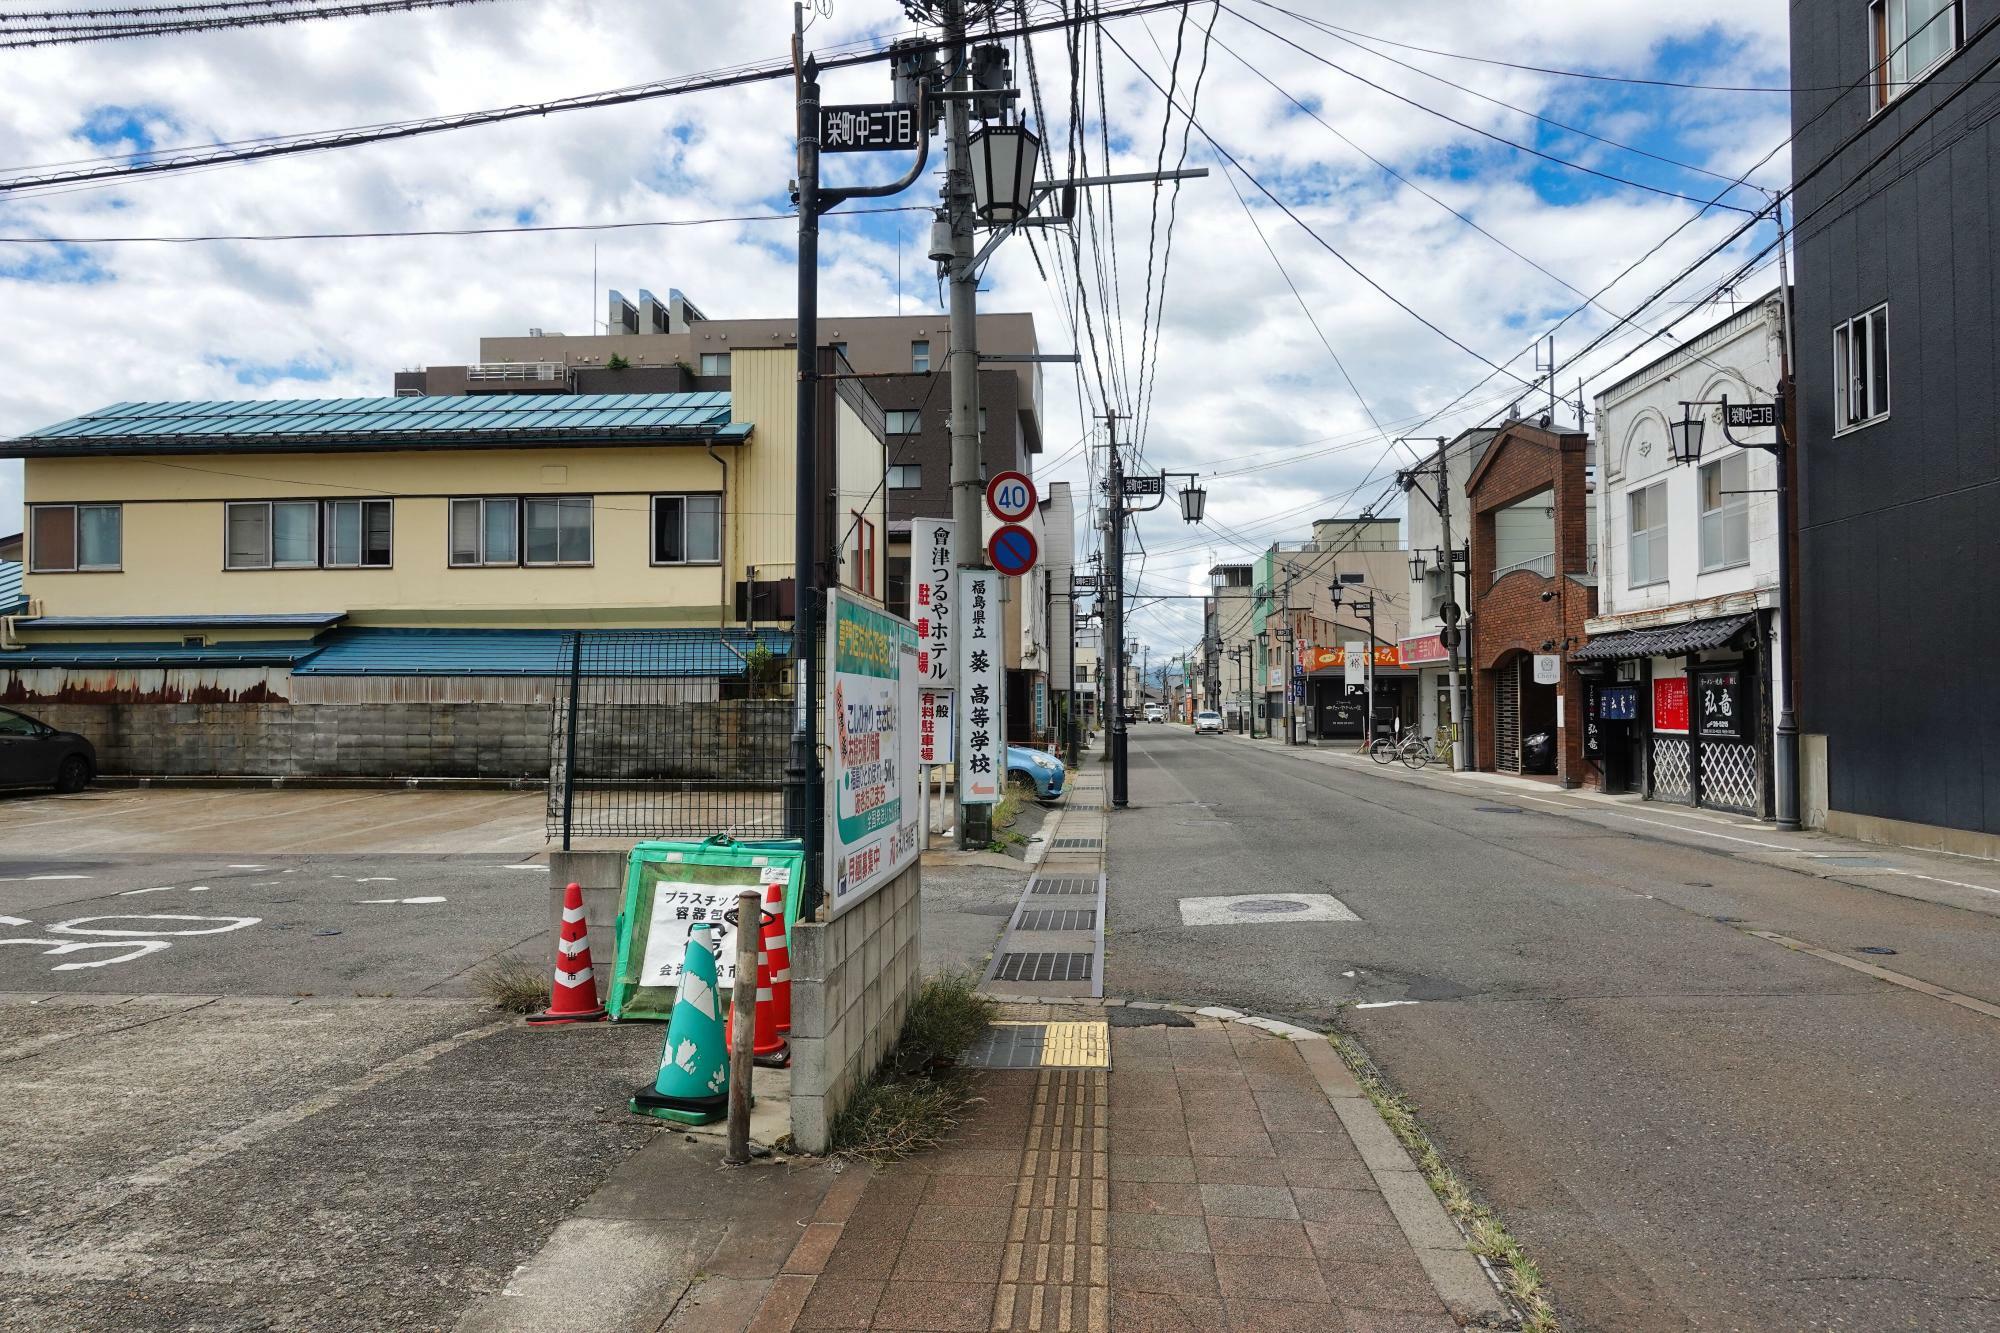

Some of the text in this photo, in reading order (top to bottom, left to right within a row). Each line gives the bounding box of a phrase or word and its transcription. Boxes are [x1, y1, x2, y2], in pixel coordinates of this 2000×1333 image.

[827, 110, 911, 146] 栄町中三丁目
[1731, 407, 1773, 424] 栄町中三丁目
[998, 486, 1026, 509] 40
[1125, 479, 1159, 493] 栄町中三丁目
[930, 527, 951, 681] 會津つるやホテル
[918, 583, 930, 674] 駐車場
[969, 580, 991, 775] 福島県立 葵 高等学校
[1348, 686, 1355, 695] P
[935, 694, 949, 718] 一般
[920, 692, 935, 761] 有料駐車場
